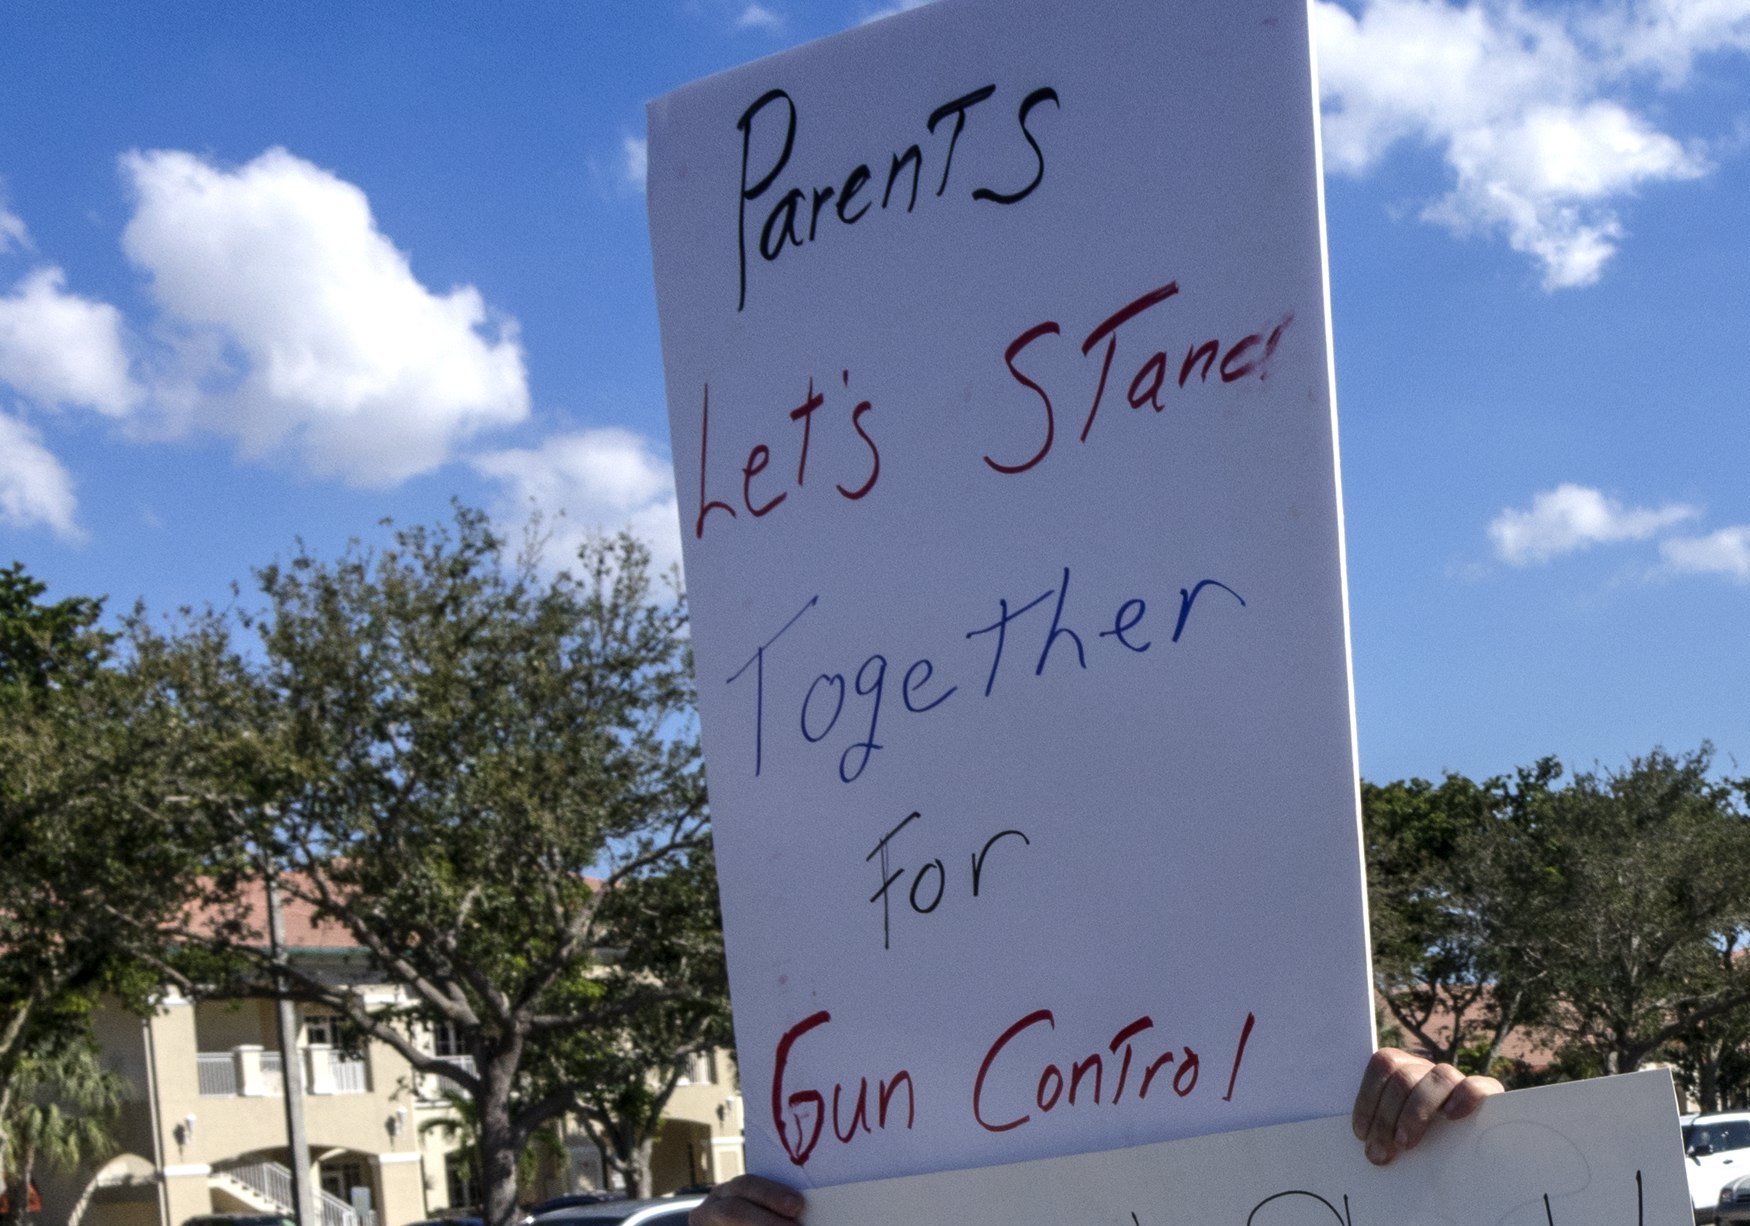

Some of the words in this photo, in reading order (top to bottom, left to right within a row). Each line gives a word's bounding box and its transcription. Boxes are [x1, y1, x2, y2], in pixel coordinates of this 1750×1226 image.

[696, 369, 880, 540] Let's
[726, 567, 1246, 783] Together
[866, 811, 1030, 950] For
[771, 1010, 915, 1167] Gun
